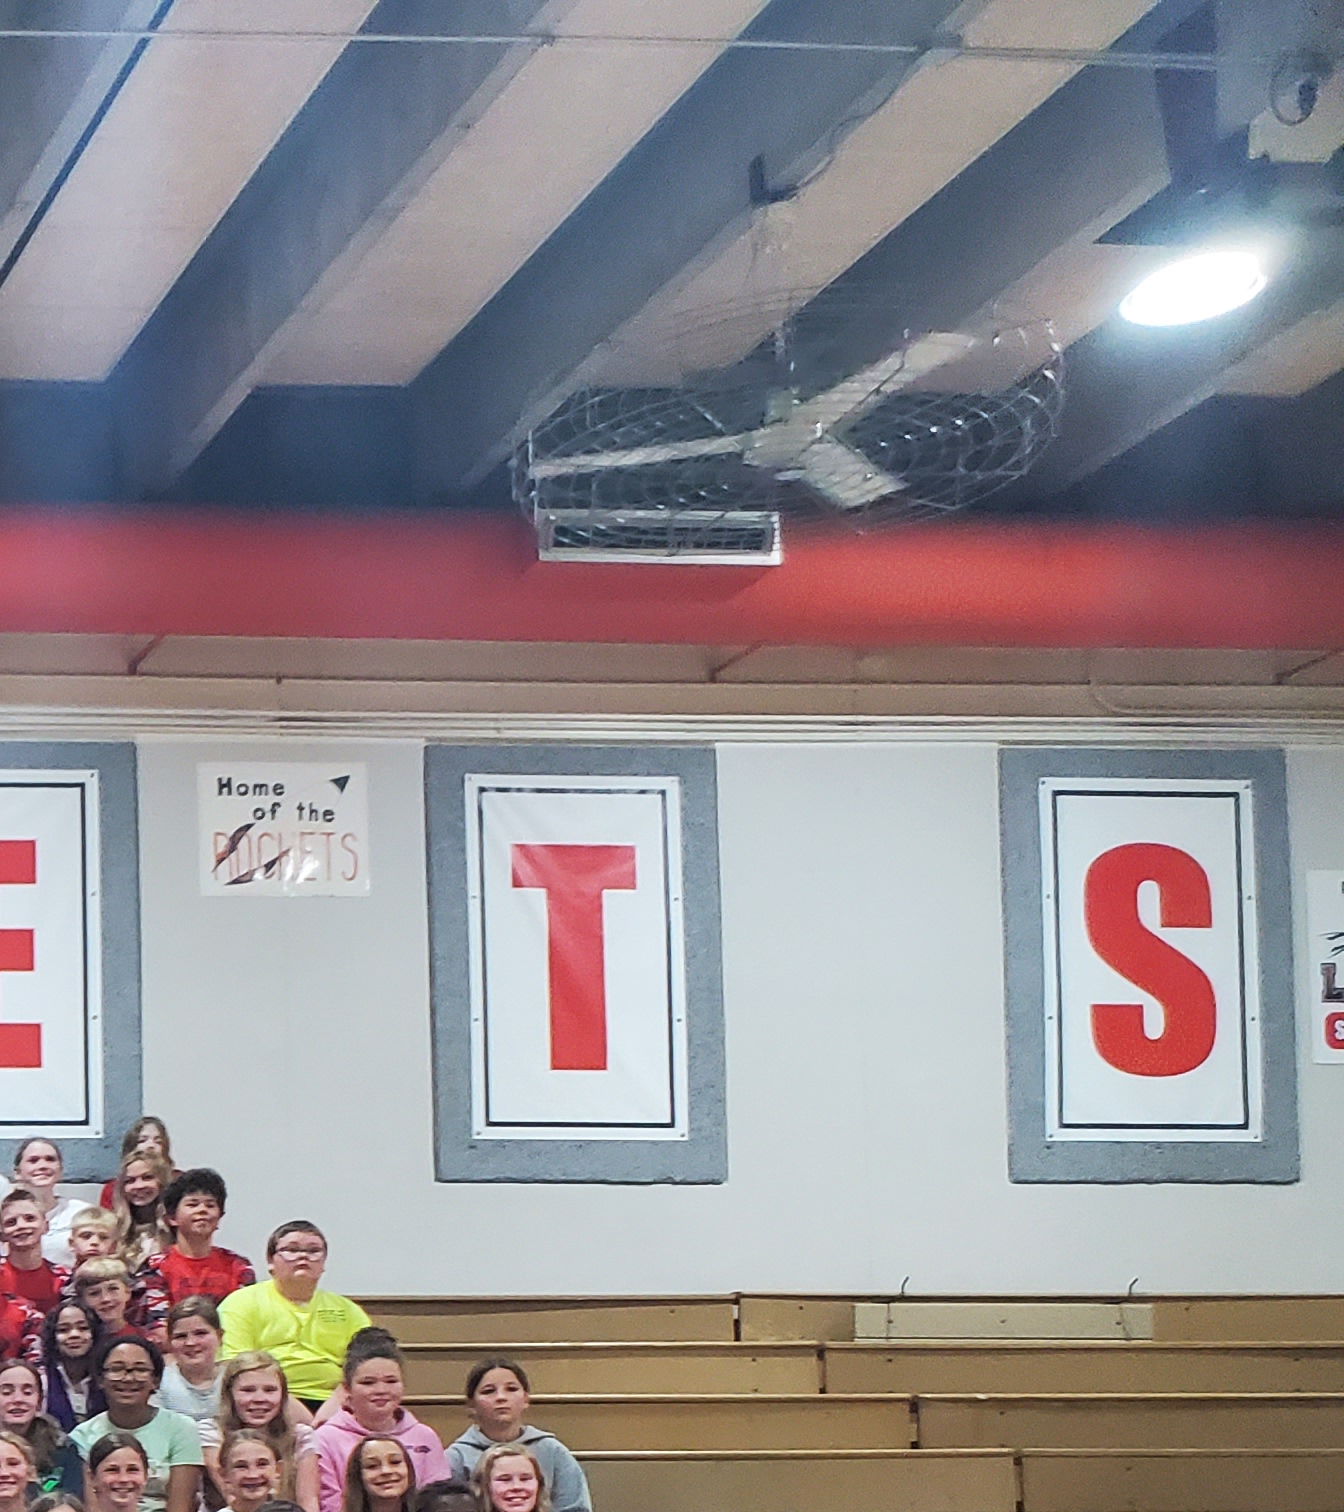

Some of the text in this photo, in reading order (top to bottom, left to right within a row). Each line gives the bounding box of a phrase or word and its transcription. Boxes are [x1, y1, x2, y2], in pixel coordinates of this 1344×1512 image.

[217, 777, 285, 797] Home
[252, 802, 335, 822] of the
[511, 844, 637, 1071] T
[1084, 842, 1216, 1077] S
